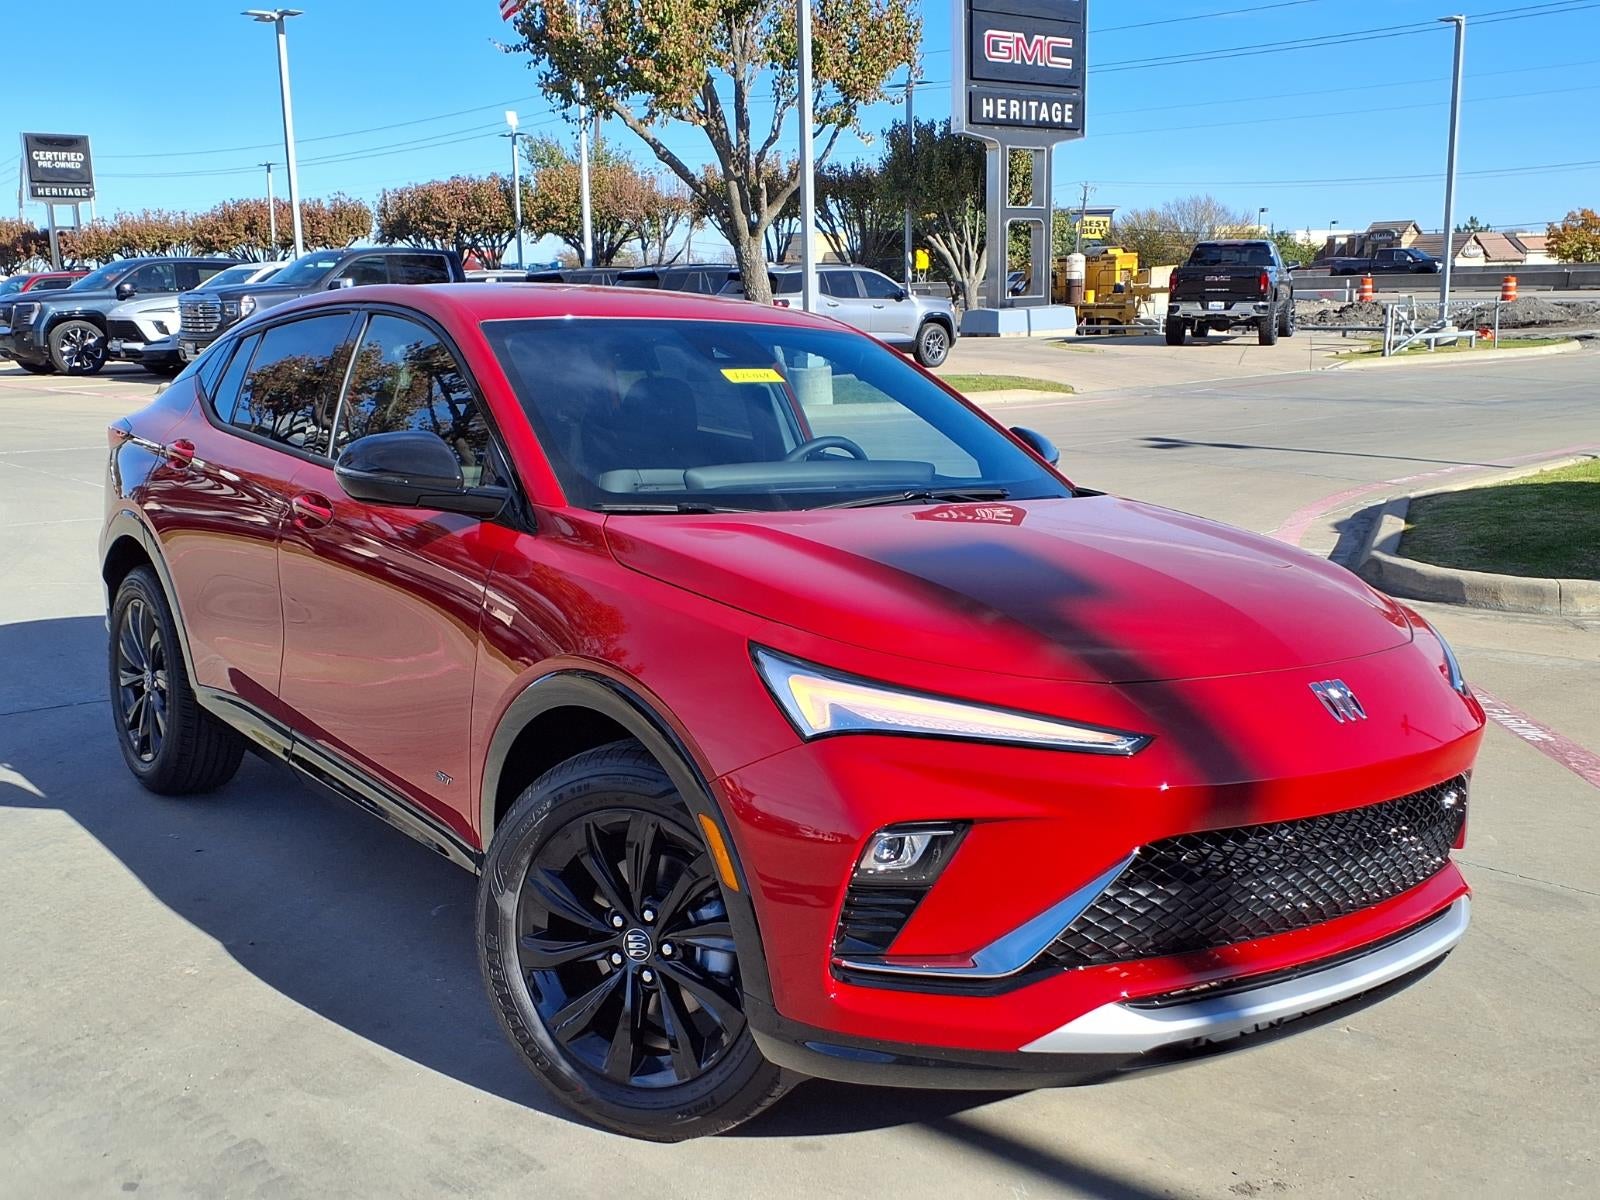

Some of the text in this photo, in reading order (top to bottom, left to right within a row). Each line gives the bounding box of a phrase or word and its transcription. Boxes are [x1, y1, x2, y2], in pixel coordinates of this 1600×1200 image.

[984, 29, 1073, 69] GMC
[982, 97, 1073, 123] HERITAGE
[32, 150, 84, 162] CERTIFIED
[37, 160, 81, 169] PRE-OWNED
[37, 186, 88, 197] HERITAGE
[1082, 228, 1104, 236] BUY
